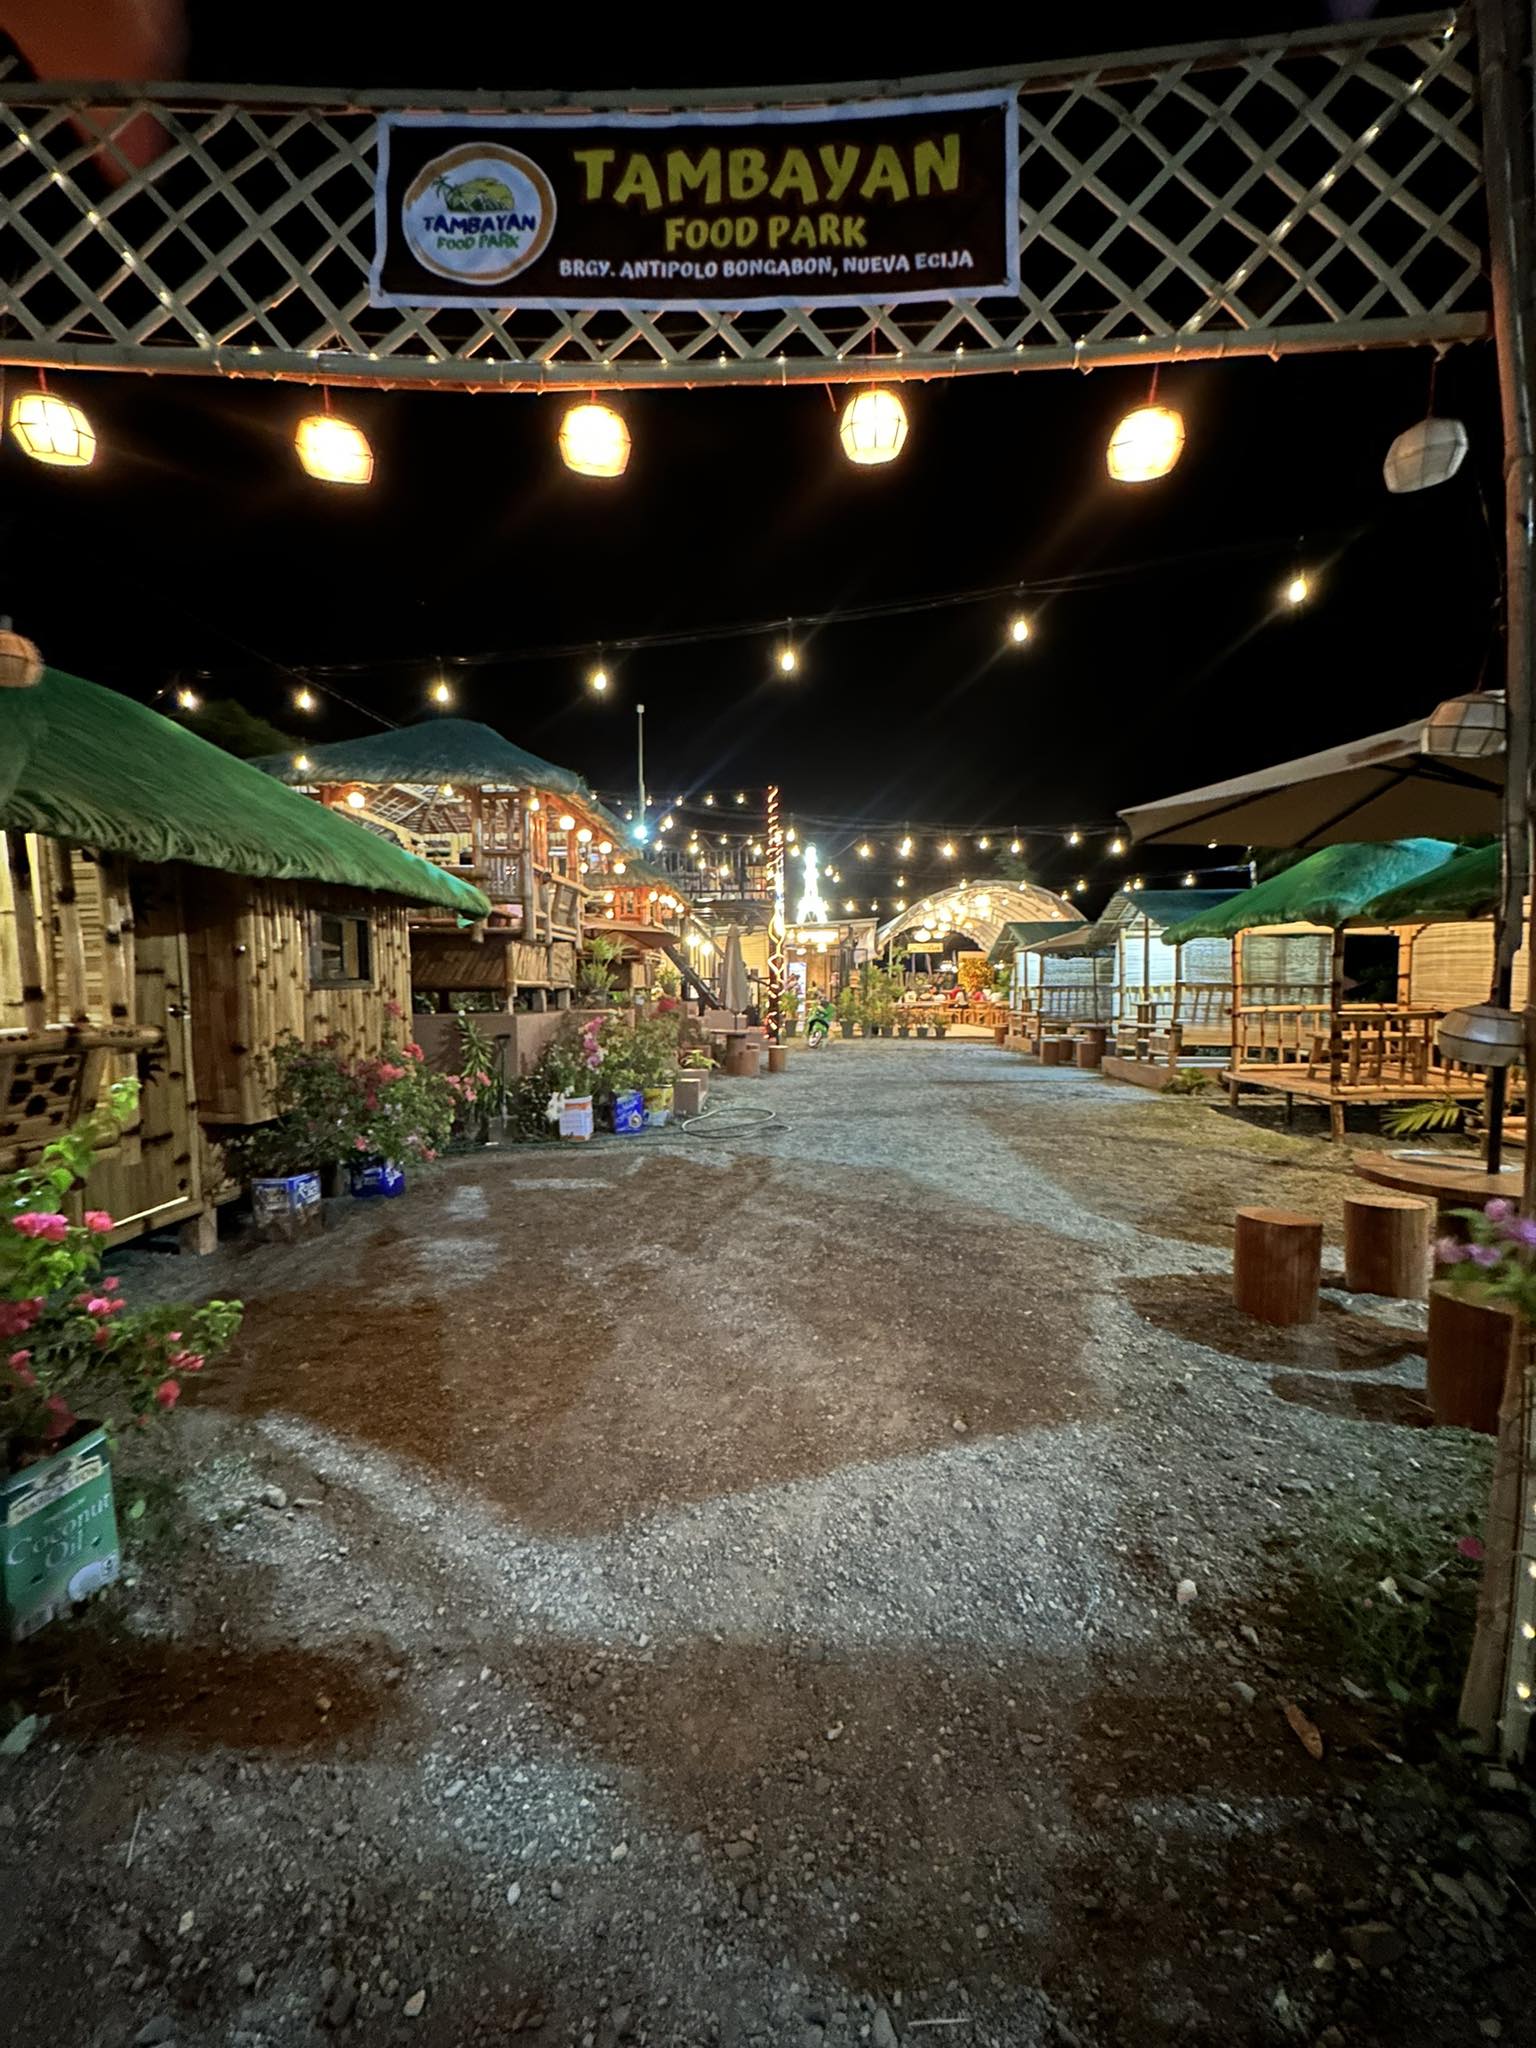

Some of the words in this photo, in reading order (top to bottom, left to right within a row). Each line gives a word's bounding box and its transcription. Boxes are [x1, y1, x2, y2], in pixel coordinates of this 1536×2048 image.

[573, 133, 961, 210] TAMBAYAN
[423, 213, 536, 235] TAMBAYAN
[664, 216, 759, 252] FOOD
[768, 212, 868, 249] PARK
[437, 236, 476, 251] FOOD
[479, 232, 520, 249] PARK
[559, 258, 616, 277] BRGY.
[619, 260, 719, 280] ANTIPOLO
[722, 256, 839, 278] BONGABON,
[843, 254, 911, 275] NUEVA
[914, 249, 974, 270] ECIJA
